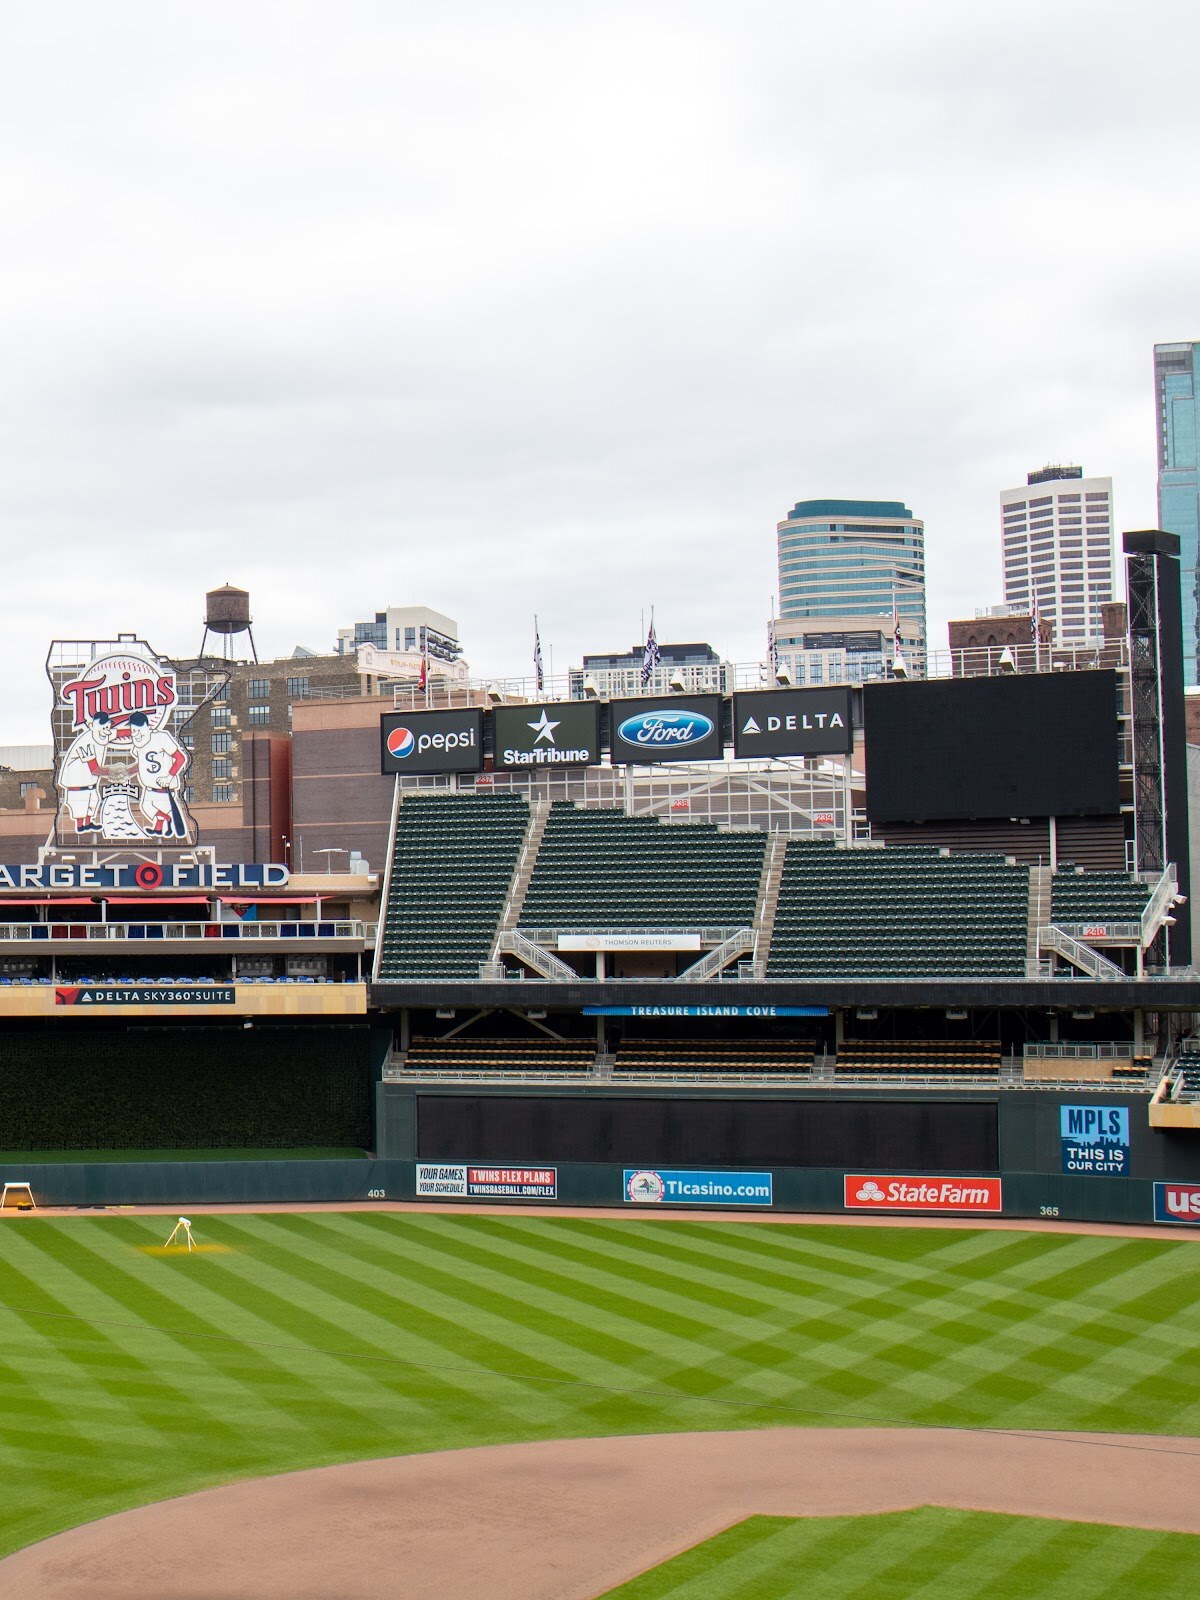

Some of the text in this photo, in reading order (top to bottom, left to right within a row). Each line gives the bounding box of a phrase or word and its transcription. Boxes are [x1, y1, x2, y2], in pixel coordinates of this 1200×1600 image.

[63, 671, 175, 728] Twins
[767, 711, 844, 733] DELTA
[637, 717, 694, 743] Ford
[418, 727, 474, 754] pepsi
[504, 747, 589, 764] StarTribune
[477, 775, 492, 783] 237
[673, 799, 688, 807] 238
[816, 813, 832, 821] 239
[172, 863, 289, 887] FIELD
[1087, 927, 1105, 936] 240
[640, 938, 673, 946] REUTERS
[96, 991, 140, 1001] DELTA
[631, 1006, 777, 1016] TREASURE ISLAND COVE
[1068, 1109, 1120, 1135] MPLS
[1067, 1148, 1124, 1161] THIS IS
[1067, 1161, 1124, 1172] OUR CITY
[420, 1168, 439, 1180] YOUR
[472, 1170, 550, 1183] TWINS FLEX PLANS
[367, 1189, 386, 1198] 403
[420, 1182, 464, 1193] YOUR SCHEDULE
[469, 1184, 554, 1196] TWINSBASEBALL.COM/FLEX
[666, 1180, 769, 1197] TIcasino.com
[1040, 1206, 1059, 1217] 365
